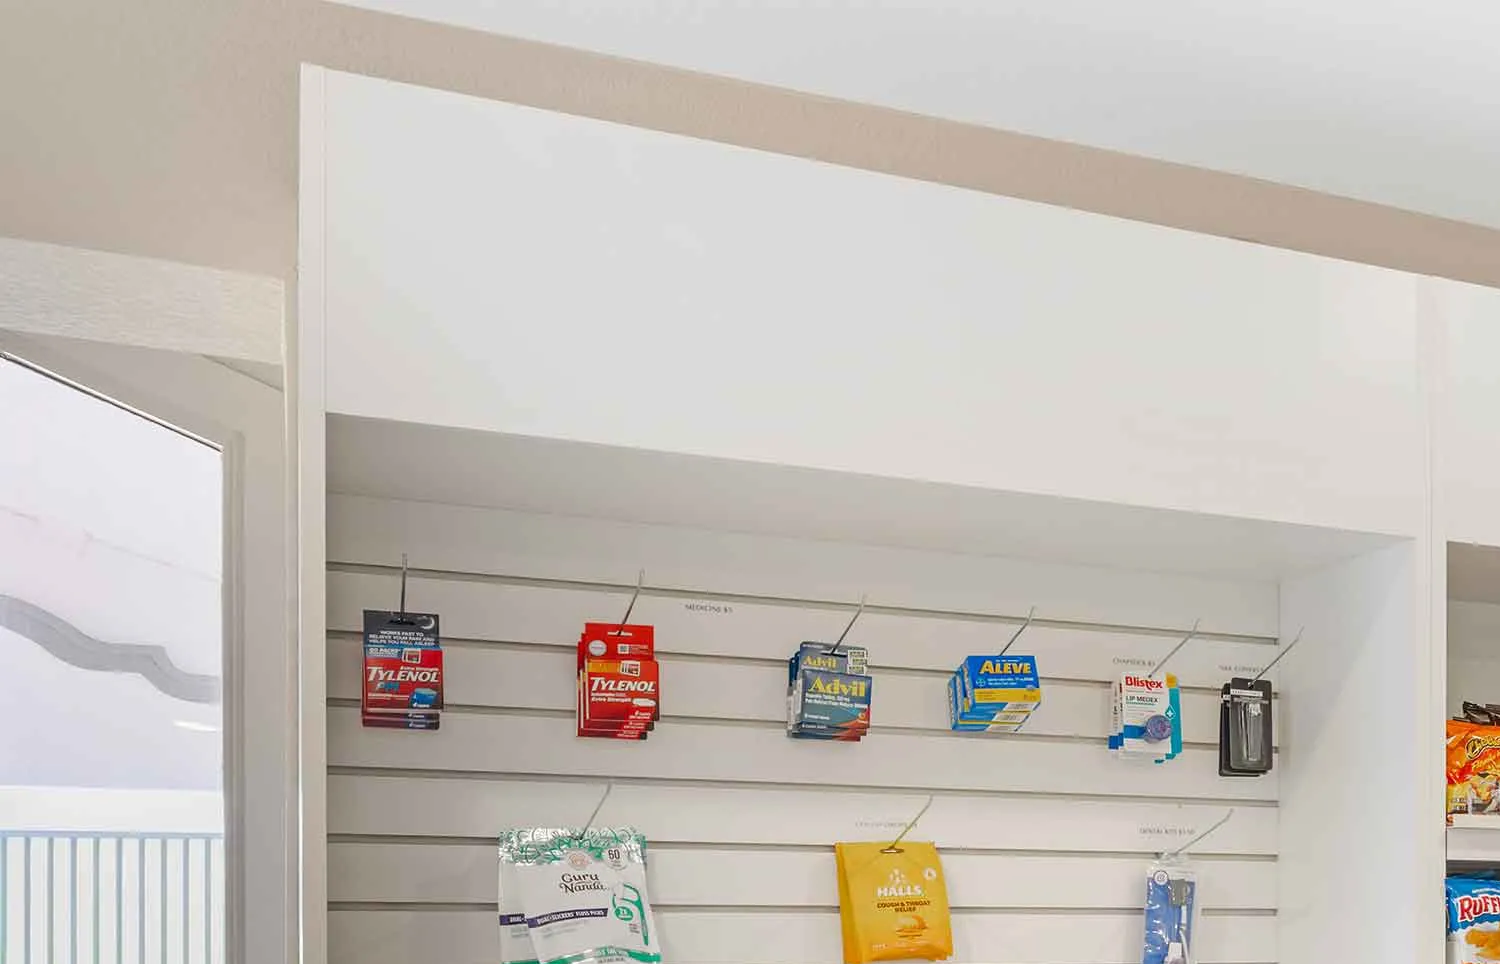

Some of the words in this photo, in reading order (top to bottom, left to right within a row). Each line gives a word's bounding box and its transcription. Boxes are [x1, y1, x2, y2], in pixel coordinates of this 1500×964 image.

[803, 655, 837, 669] Advil
[979, 660, 1032, 674] ALEVE
[367, 666, 440, 683] TYLENOL
[590, 677, 656, 692] TYLENOL
[808, 677, 866, 697] Advil
[1125, 676, 1163, 691] Blistex
[608, 849, 620, 860] 60
[561, 873, 600, 883] Guru
[877, 885, 922, 897] HALLS
